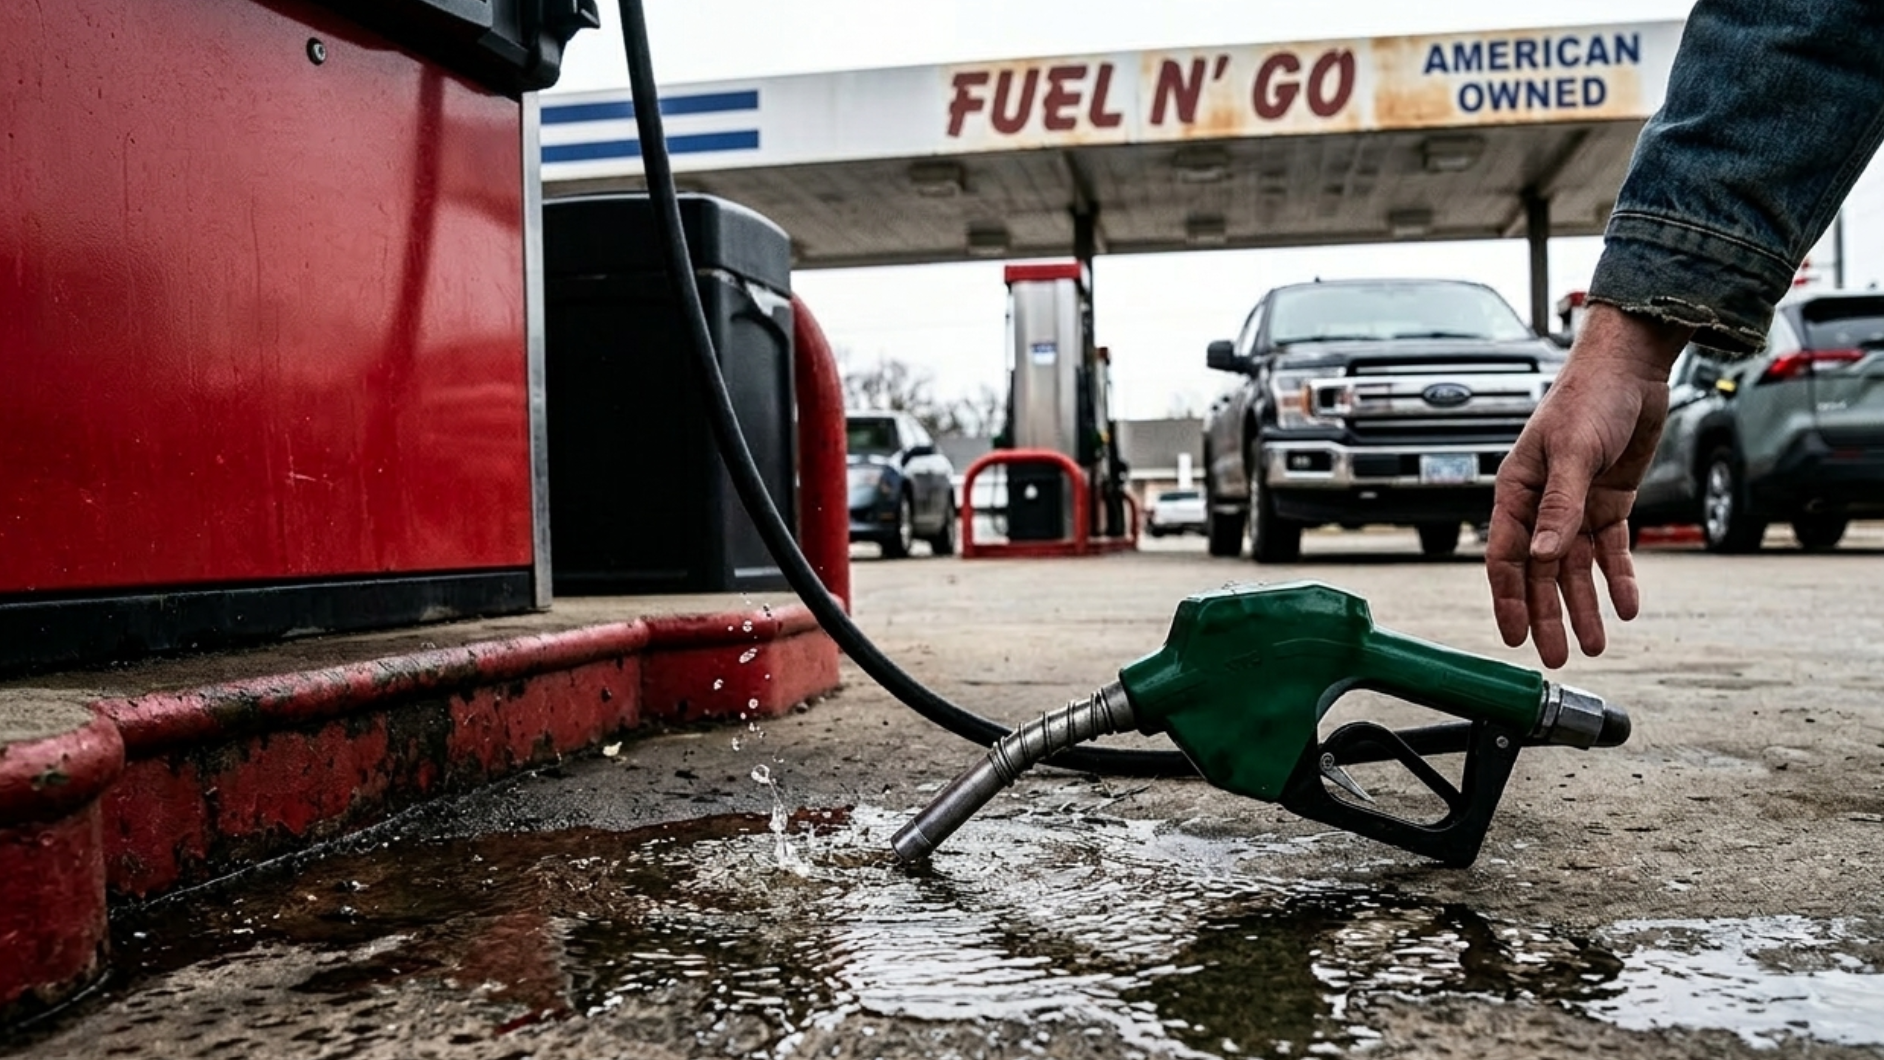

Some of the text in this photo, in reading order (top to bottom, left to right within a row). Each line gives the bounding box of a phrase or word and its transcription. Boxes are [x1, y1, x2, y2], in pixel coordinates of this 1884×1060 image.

[1423, 31, 1641, 75] AMERICAN
[947, 49, 1356, 137] FUEL N' GO
[1457, 76, 1607, 113] OWNED
